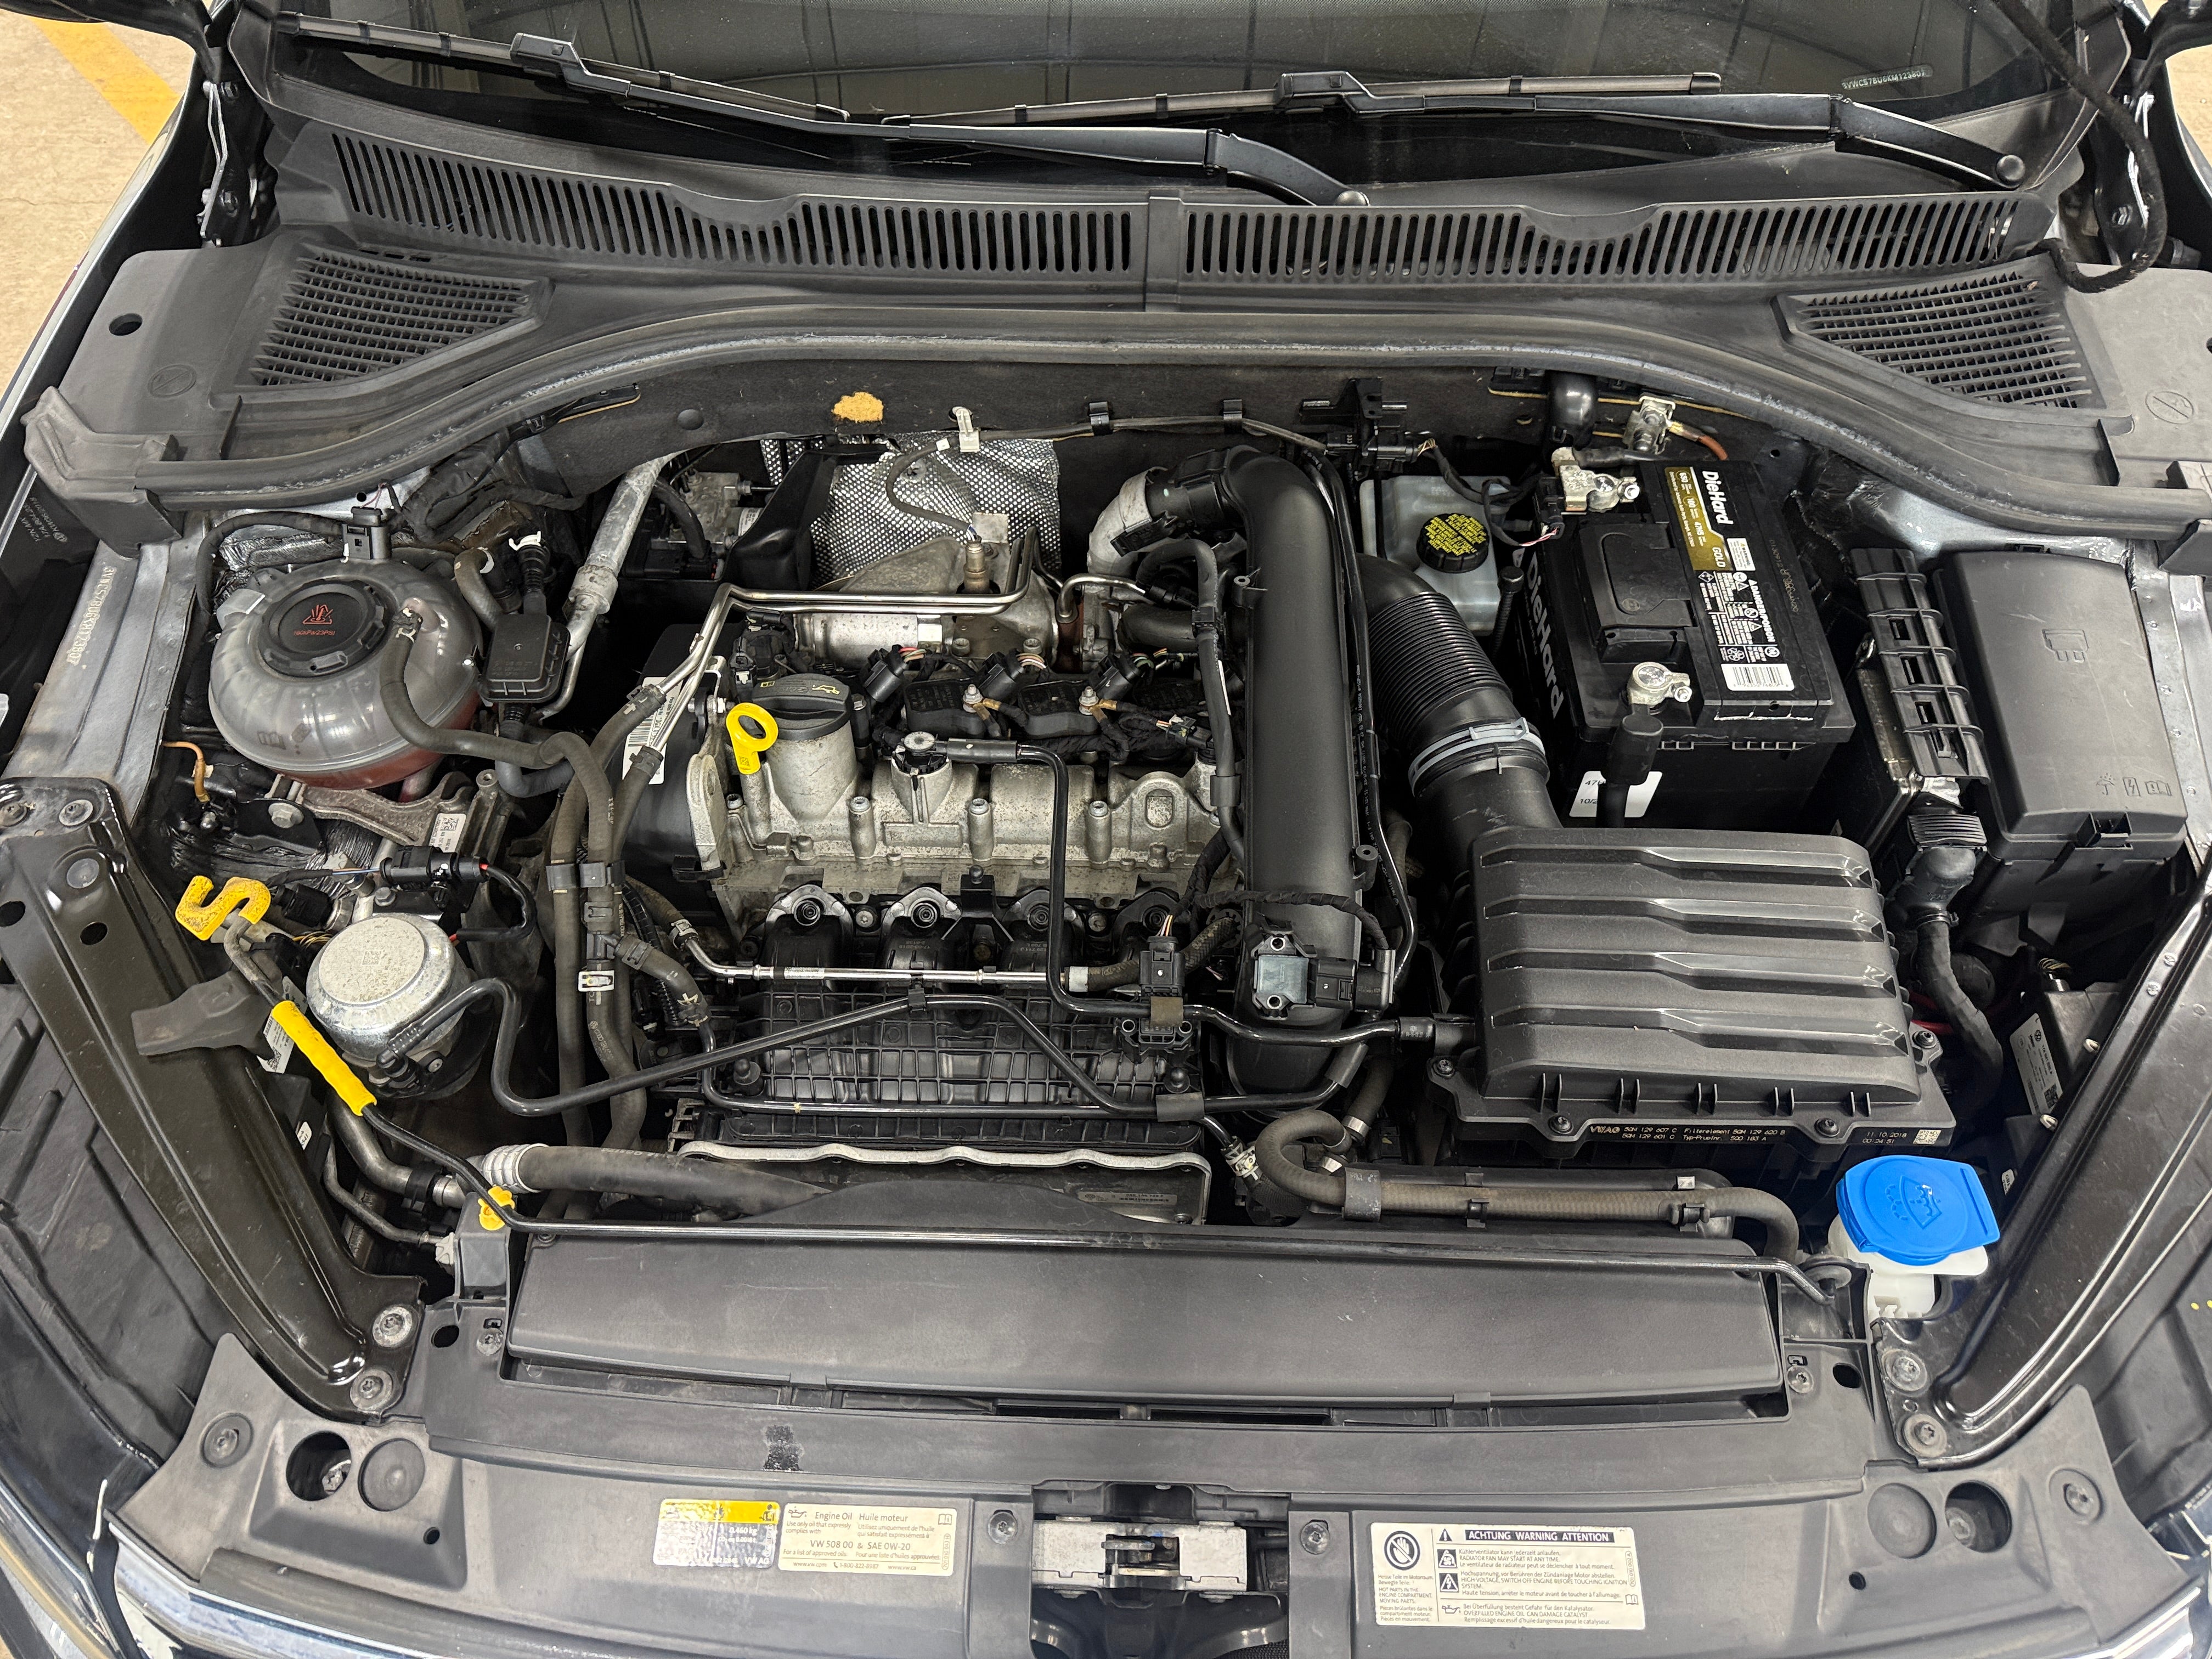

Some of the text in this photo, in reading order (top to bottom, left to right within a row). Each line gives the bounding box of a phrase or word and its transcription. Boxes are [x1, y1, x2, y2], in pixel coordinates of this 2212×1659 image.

[1679, 472, 1688, 483] 650
[1686, 498, 1696, 509] 100
[1702, 471, 1734, 525] DieHard
[1712, 547, 1725, 568] GOLD
[1752, 585, 1776, 643] DANGER/POISON
[1527, 552, 1564, 719] DieHard
[815, 1511, 840, 1522] Engine
[859, 1513, 908, 1522] Huile moteur
[749, 1527, 757, 1536] kg
[1469, 1531, 1609, 1542] ACHTUNG WARNING ATTENTION
[826, 1540, 840, 1548] 508
[884, 1542, 910, 1550] 0W-20
